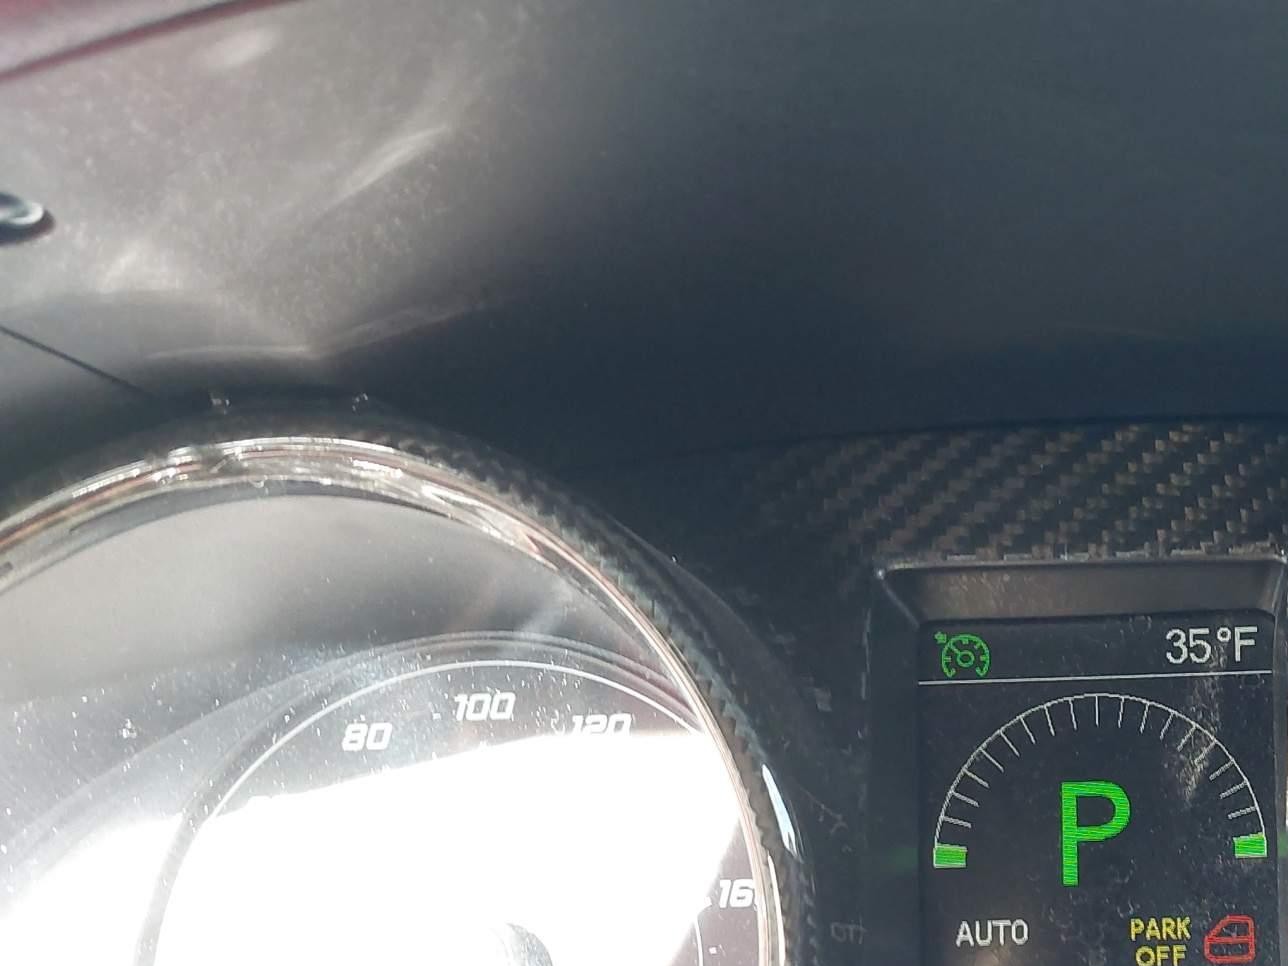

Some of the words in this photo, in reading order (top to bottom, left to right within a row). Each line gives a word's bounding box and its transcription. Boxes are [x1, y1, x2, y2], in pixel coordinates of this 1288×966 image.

[1165, 626, 1258, 664] 35°F
[454, 692, 516, 720] 100
[342, 722, 392, 751] 80
[1061, 781, 1131, 887] P
[719, 879, 757, 908] 16
[955, 919, 1029, 947] AUTO
[1129, 917, 1191, 941] PARK
